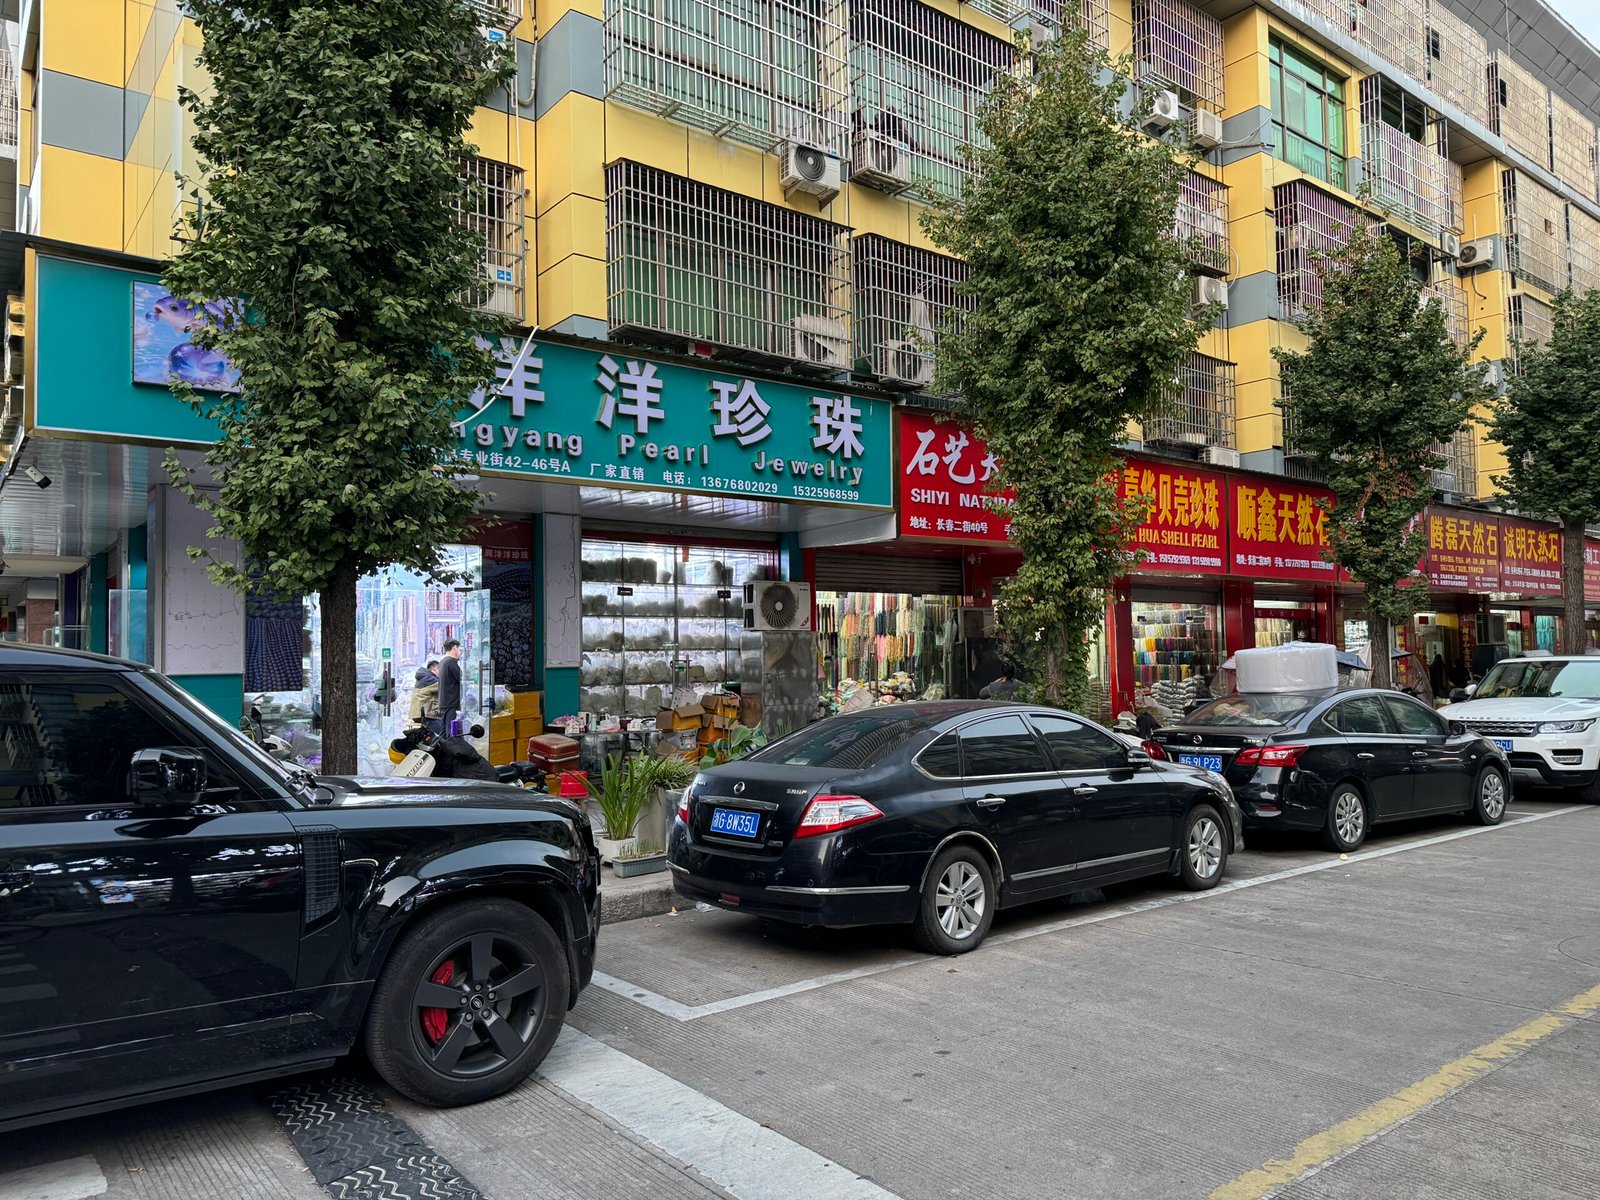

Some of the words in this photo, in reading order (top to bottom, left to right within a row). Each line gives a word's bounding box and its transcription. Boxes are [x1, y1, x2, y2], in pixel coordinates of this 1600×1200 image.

[618, 434, 708, 465] Pearl
[754, 451, 863, 486] Jewelry
[589, 463, 644, 481] 厂家直销
[700, 476, 778, 493] 13676802029
[792, 485, 859, 501] 15325968599
[911, 488, 950, 505] SHIYI
[1138, 528, 1160, 544] HUA
[1160, 530, 1191, 547] SHELL
[1191, 533, 1219, 549] PEARL
[1430, 515, 1498, 556] 腾磊天然石
[1503, 526, 1559, 564] 诚明天然石
